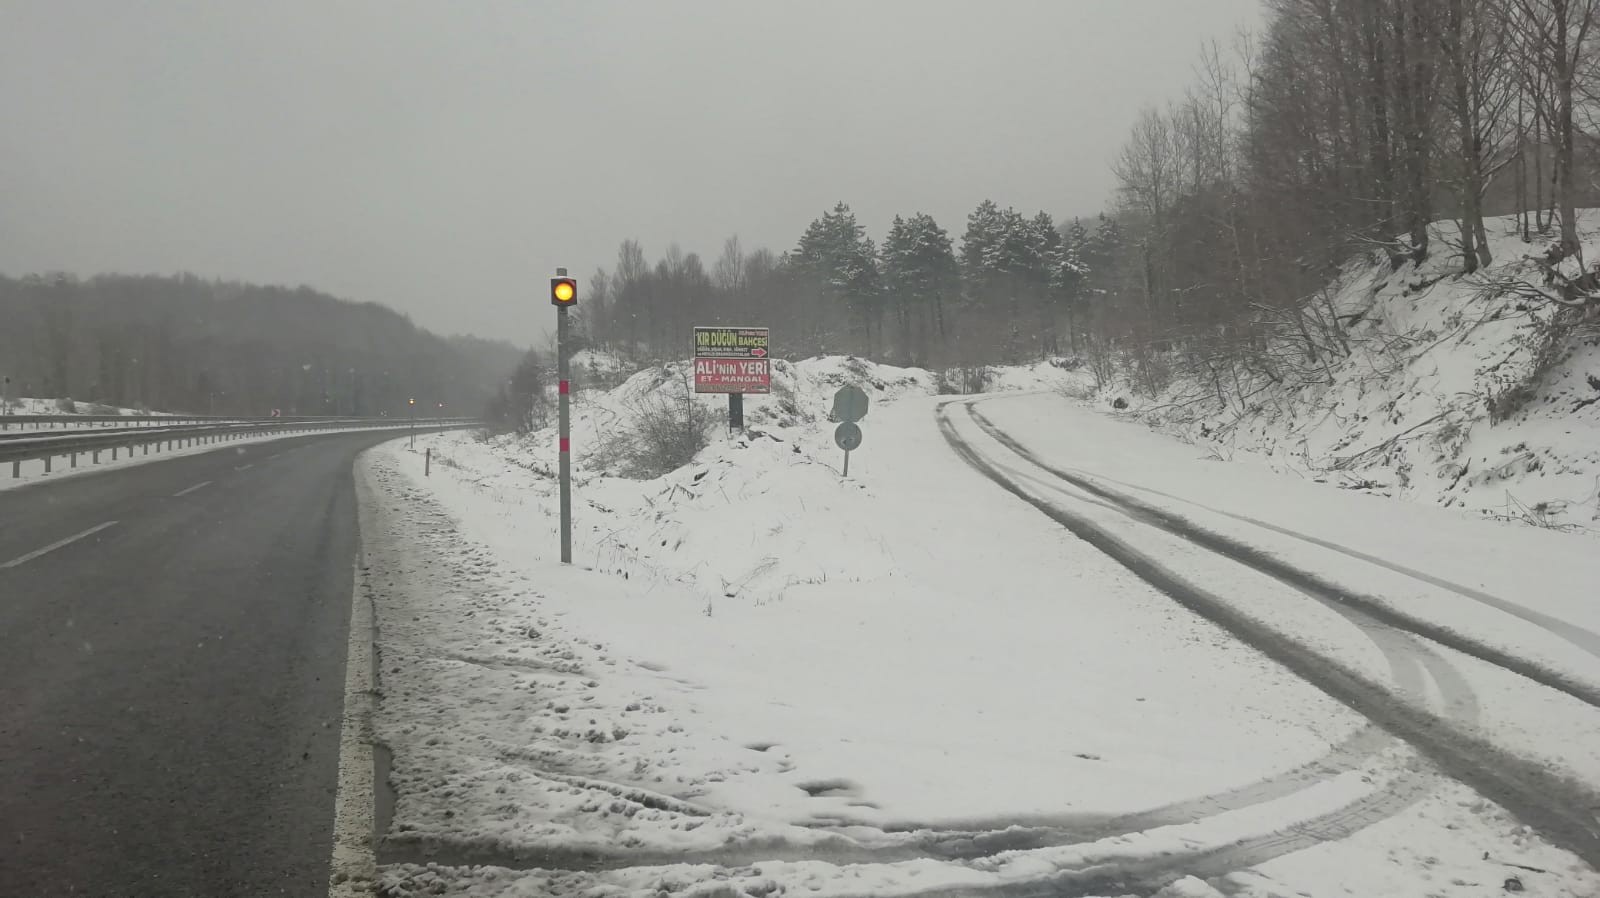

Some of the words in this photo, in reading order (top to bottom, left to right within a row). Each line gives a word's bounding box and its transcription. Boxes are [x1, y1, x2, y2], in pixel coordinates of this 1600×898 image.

[697, 332, 710, 346] KIR
[711, 330, 737, 346] DÜĞÜN
[738, 337, 768, 347] BAHÇESİ
[697, 360, 736, 374] ALİ'NİN
[740, 362, 767, 374] YERİ
